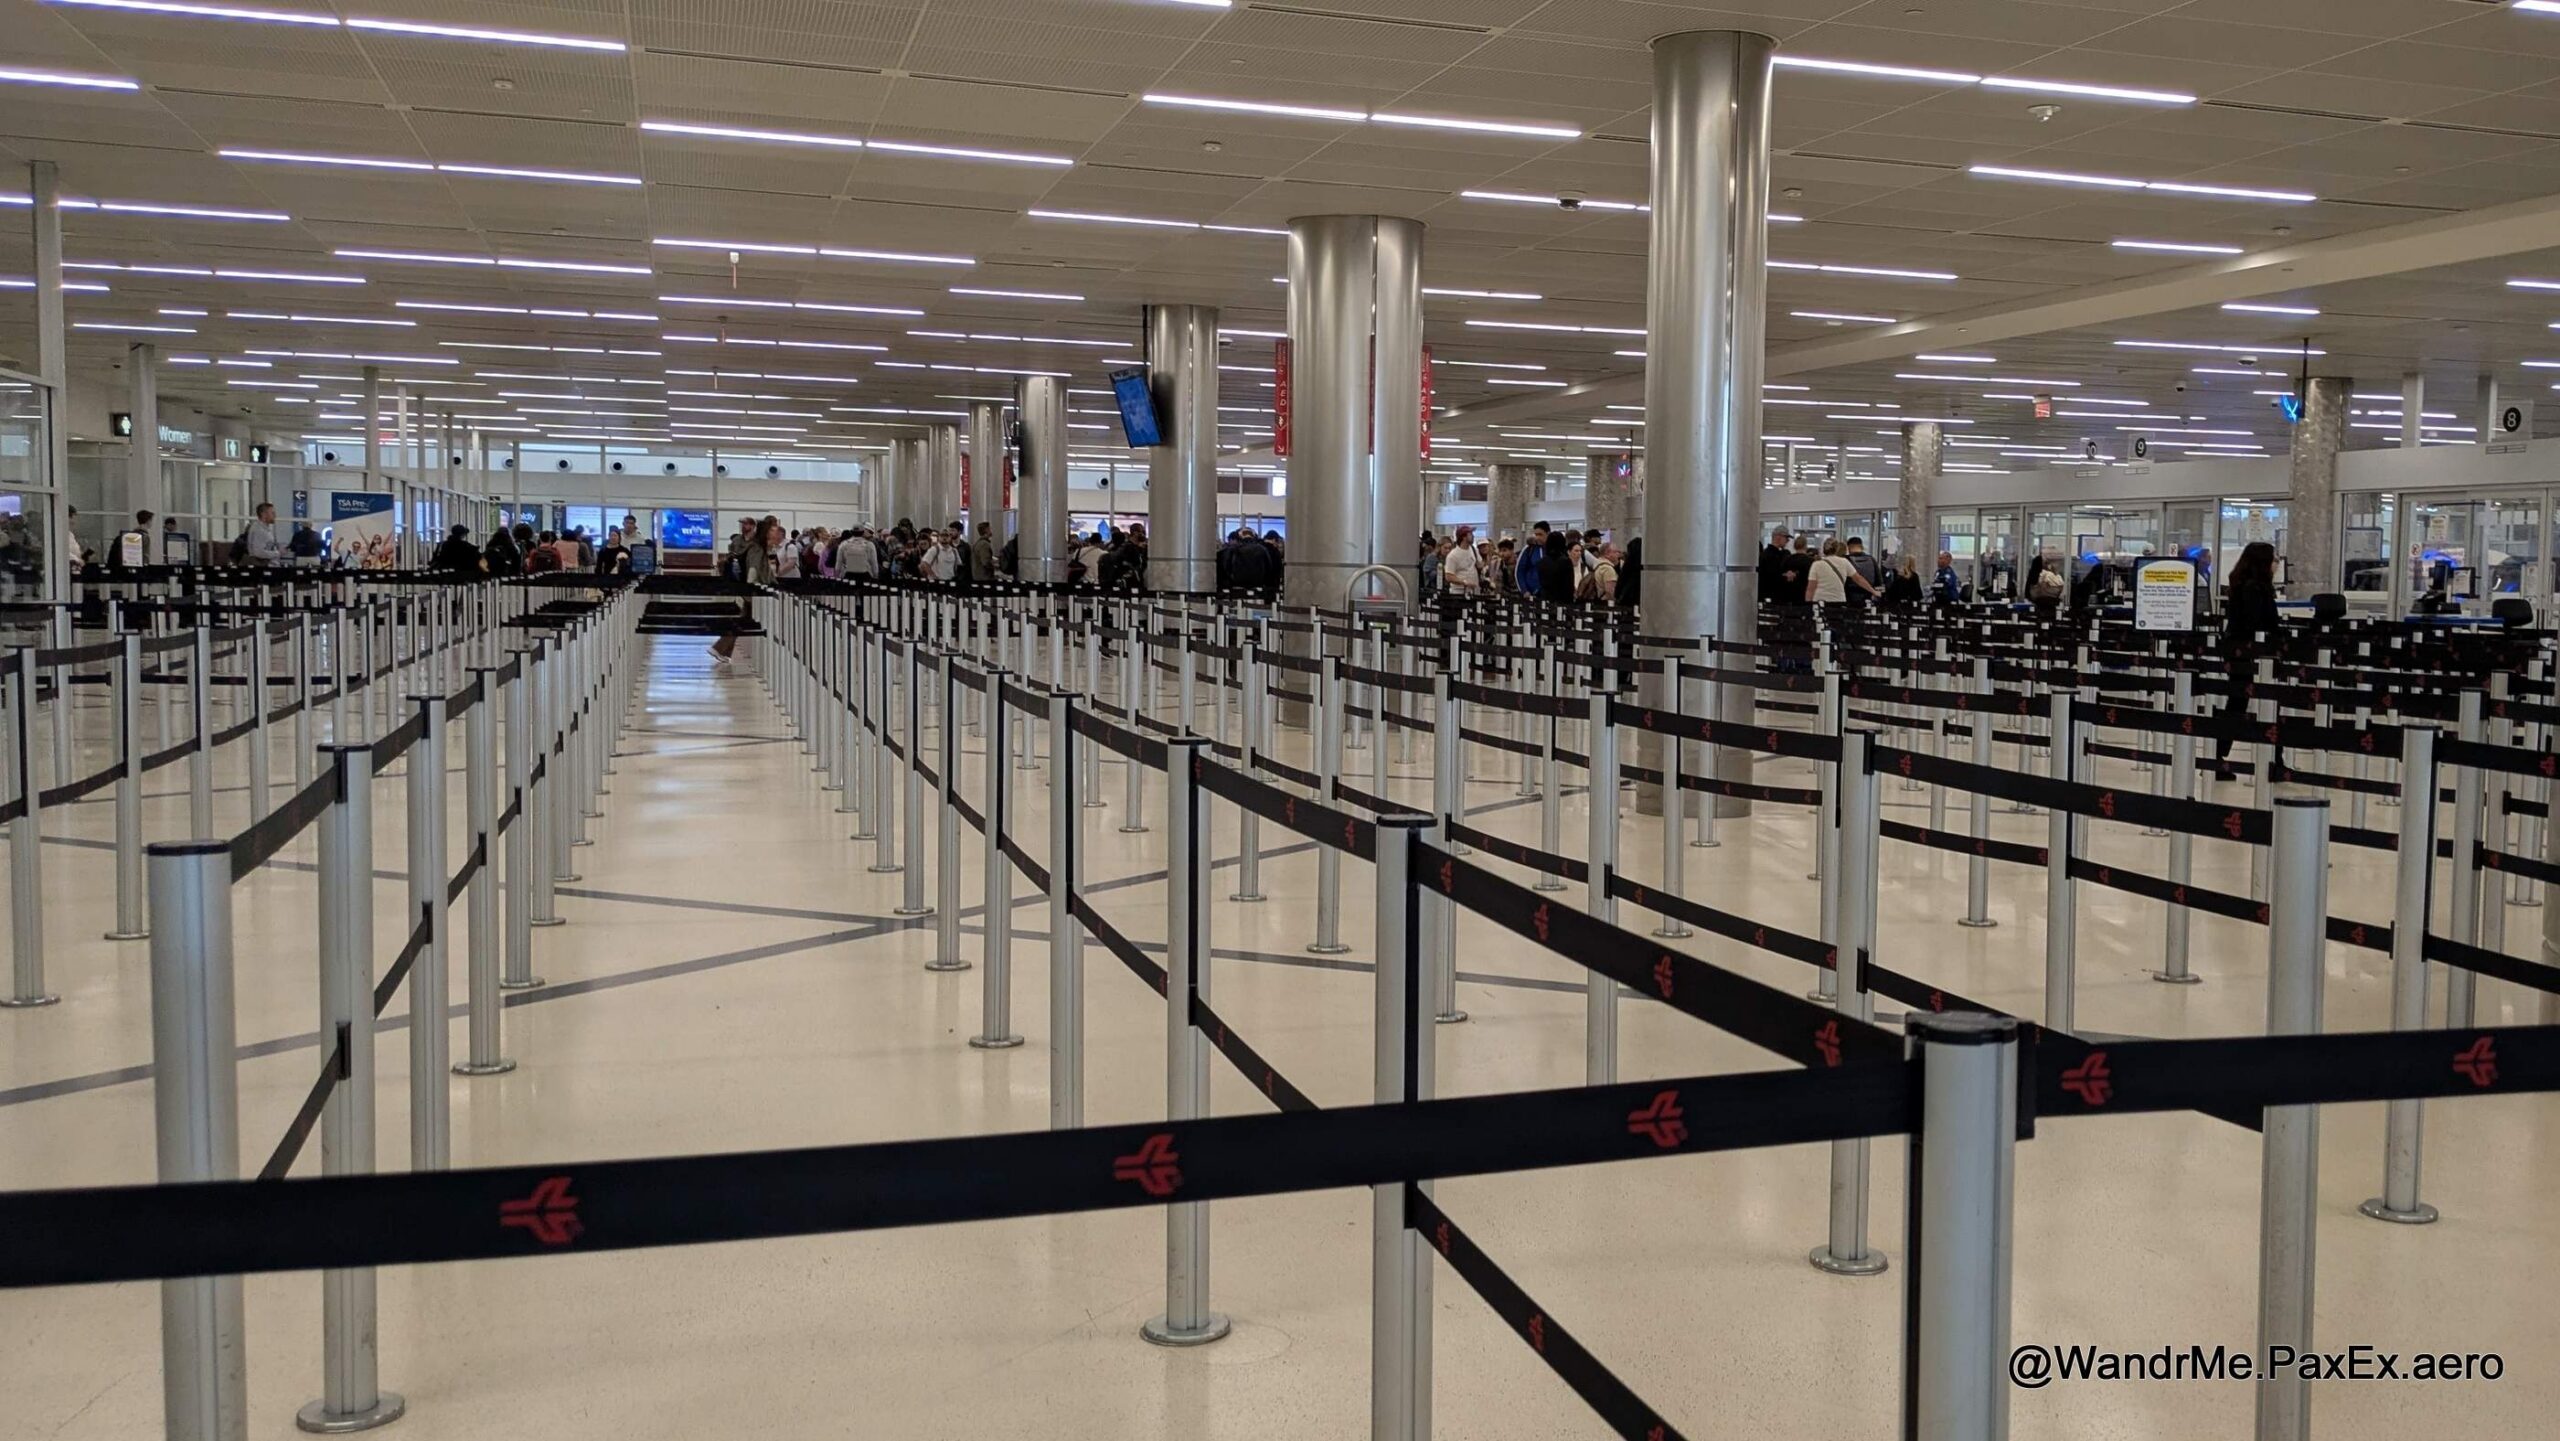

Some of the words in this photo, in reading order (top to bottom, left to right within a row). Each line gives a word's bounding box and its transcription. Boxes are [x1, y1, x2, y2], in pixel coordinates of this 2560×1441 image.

[1279, 380, 1287, 407] AED
[2507, 411, 2517, 428] 8
[158, 425, 192, 444] Women
[337, 498, 352, 507] TSA
